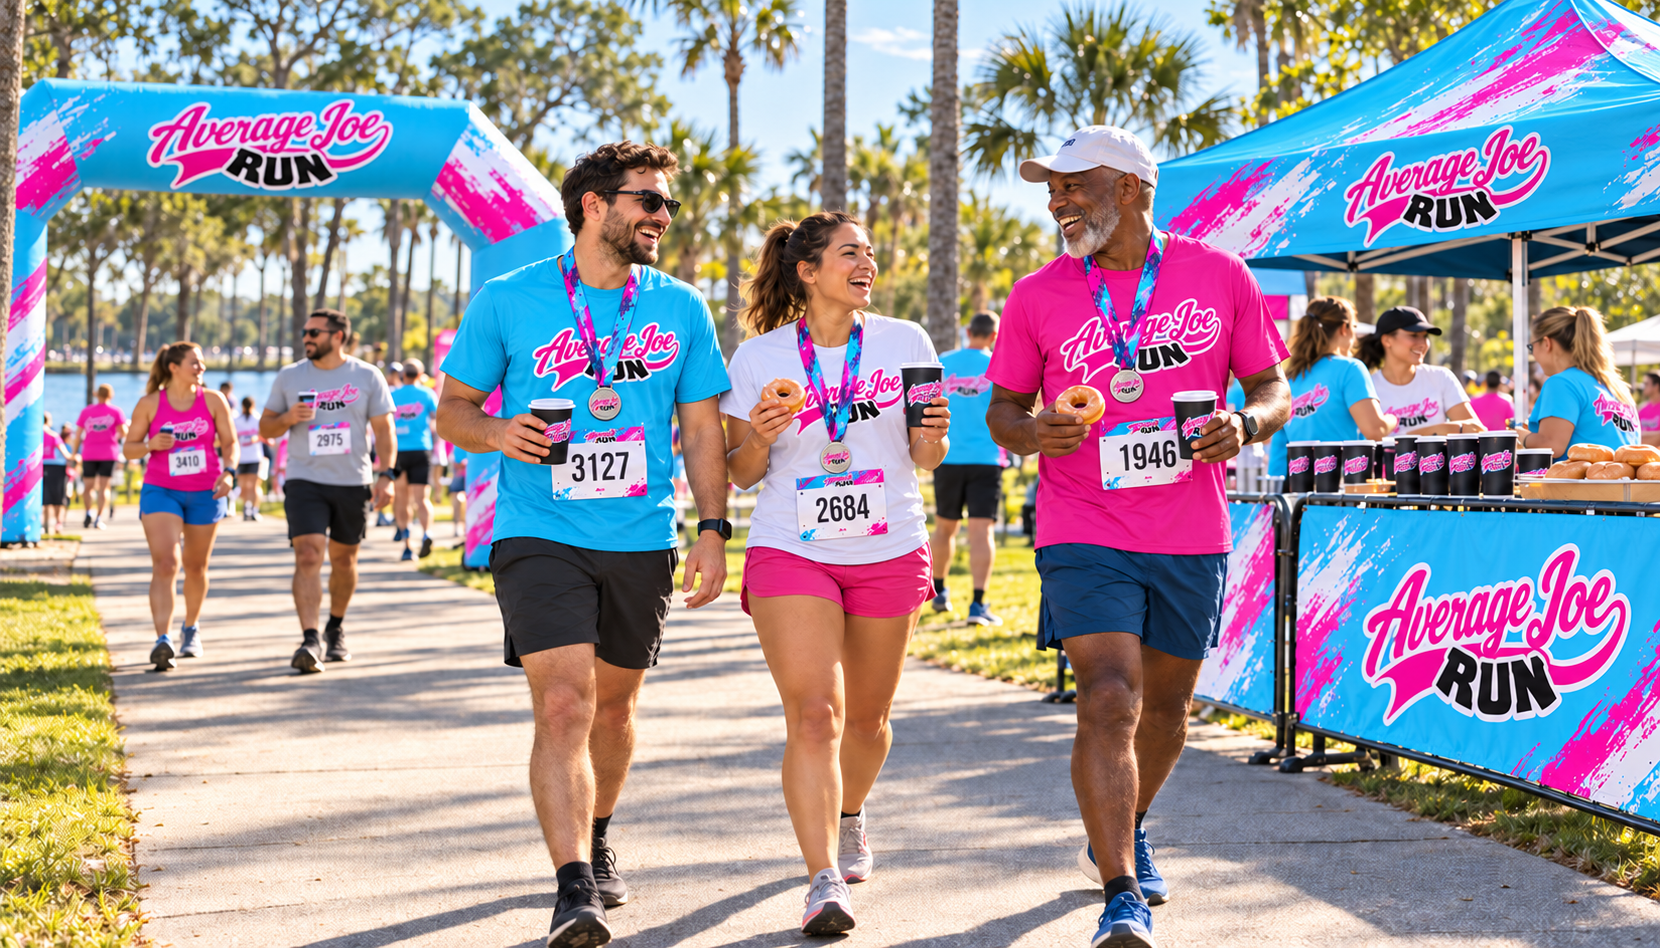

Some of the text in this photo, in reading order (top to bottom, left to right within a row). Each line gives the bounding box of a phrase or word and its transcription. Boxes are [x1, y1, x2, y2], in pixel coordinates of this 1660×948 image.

[149, 101, 382, 164] Average Joe
[225, 147, 334, 187] RUN
[1346, 128, 1538, 223] Average Joe
[1402, 190, 1498, 229] RUN
[534, 324, 675, 376] Avee Joe
[1062, 302, 1215, 370] Avge Joe
[585, 359, 649, 380] UN
[1138, 342, 1189, 372] UN
[865, 369, 901, 399] Joe
[316, 433, 344, 447] 2975
[1119, 439, 1177, 472] 1946
[175, 454, 200, 468] 3410
[571, 451, 629, 482] 3127
[815, 493, 870, 523] 2684
[1365, 549, 1612, 678] Average Joe
[1435, 646, 1558, 716] RUN
